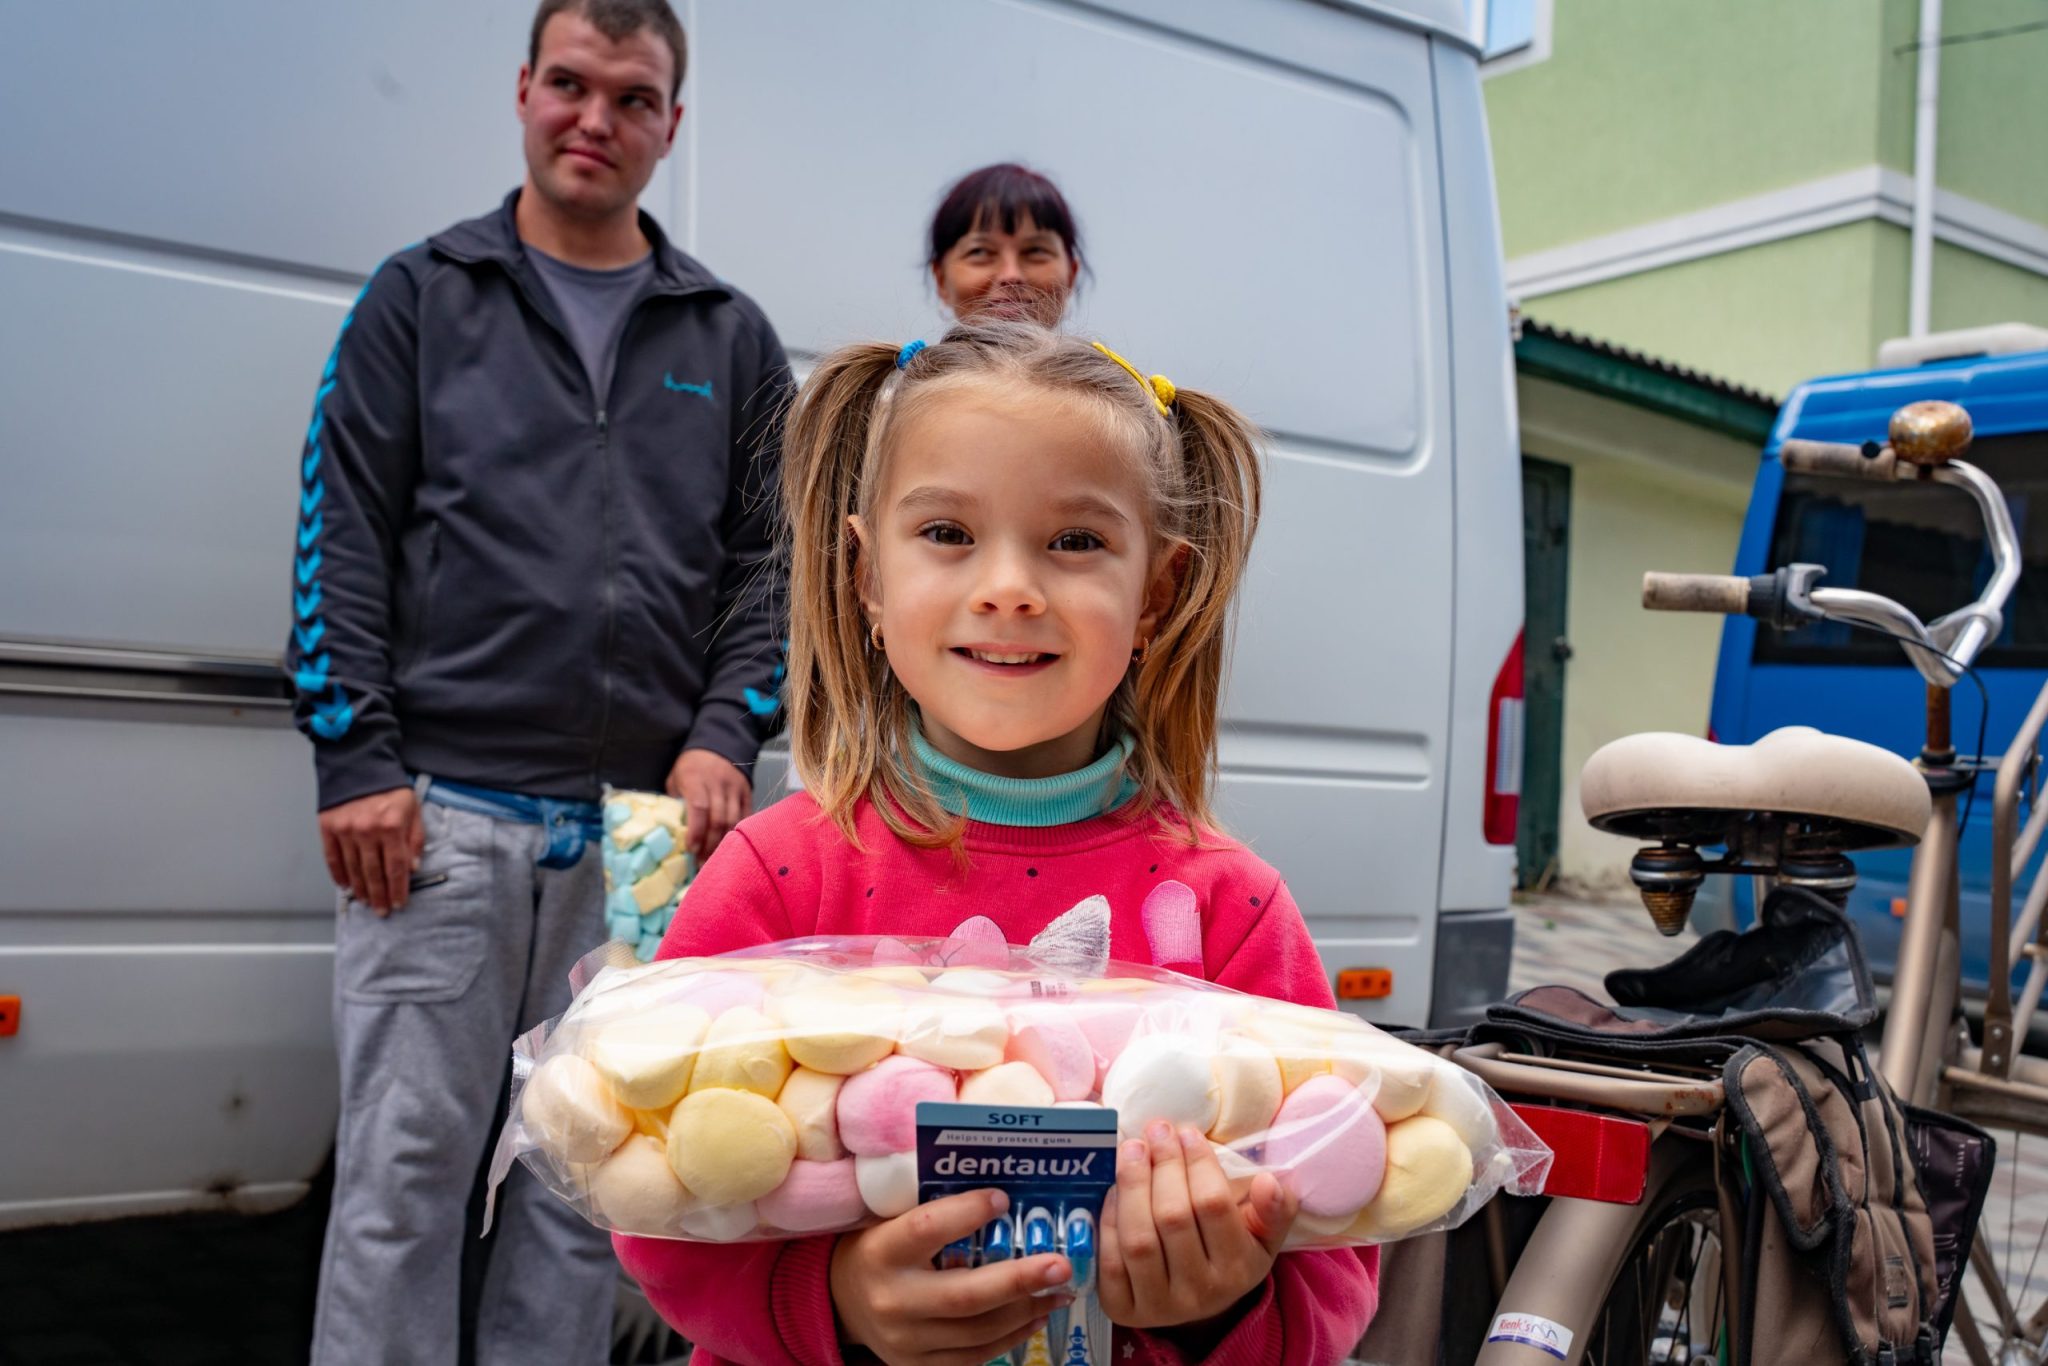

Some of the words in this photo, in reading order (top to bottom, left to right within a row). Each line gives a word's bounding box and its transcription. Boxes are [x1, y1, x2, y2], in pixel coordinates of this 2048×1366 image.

[988, 1113, 1044, 1126] SOFT
[946, 1133, 978, 1144] Helps
[982, 1134, 994, 1143] to
[997, 1135, 1039, 1144] protect
[1043, 1137, 1073, 1146] gums
[933, 1151, 1097, 1176] dentalux
